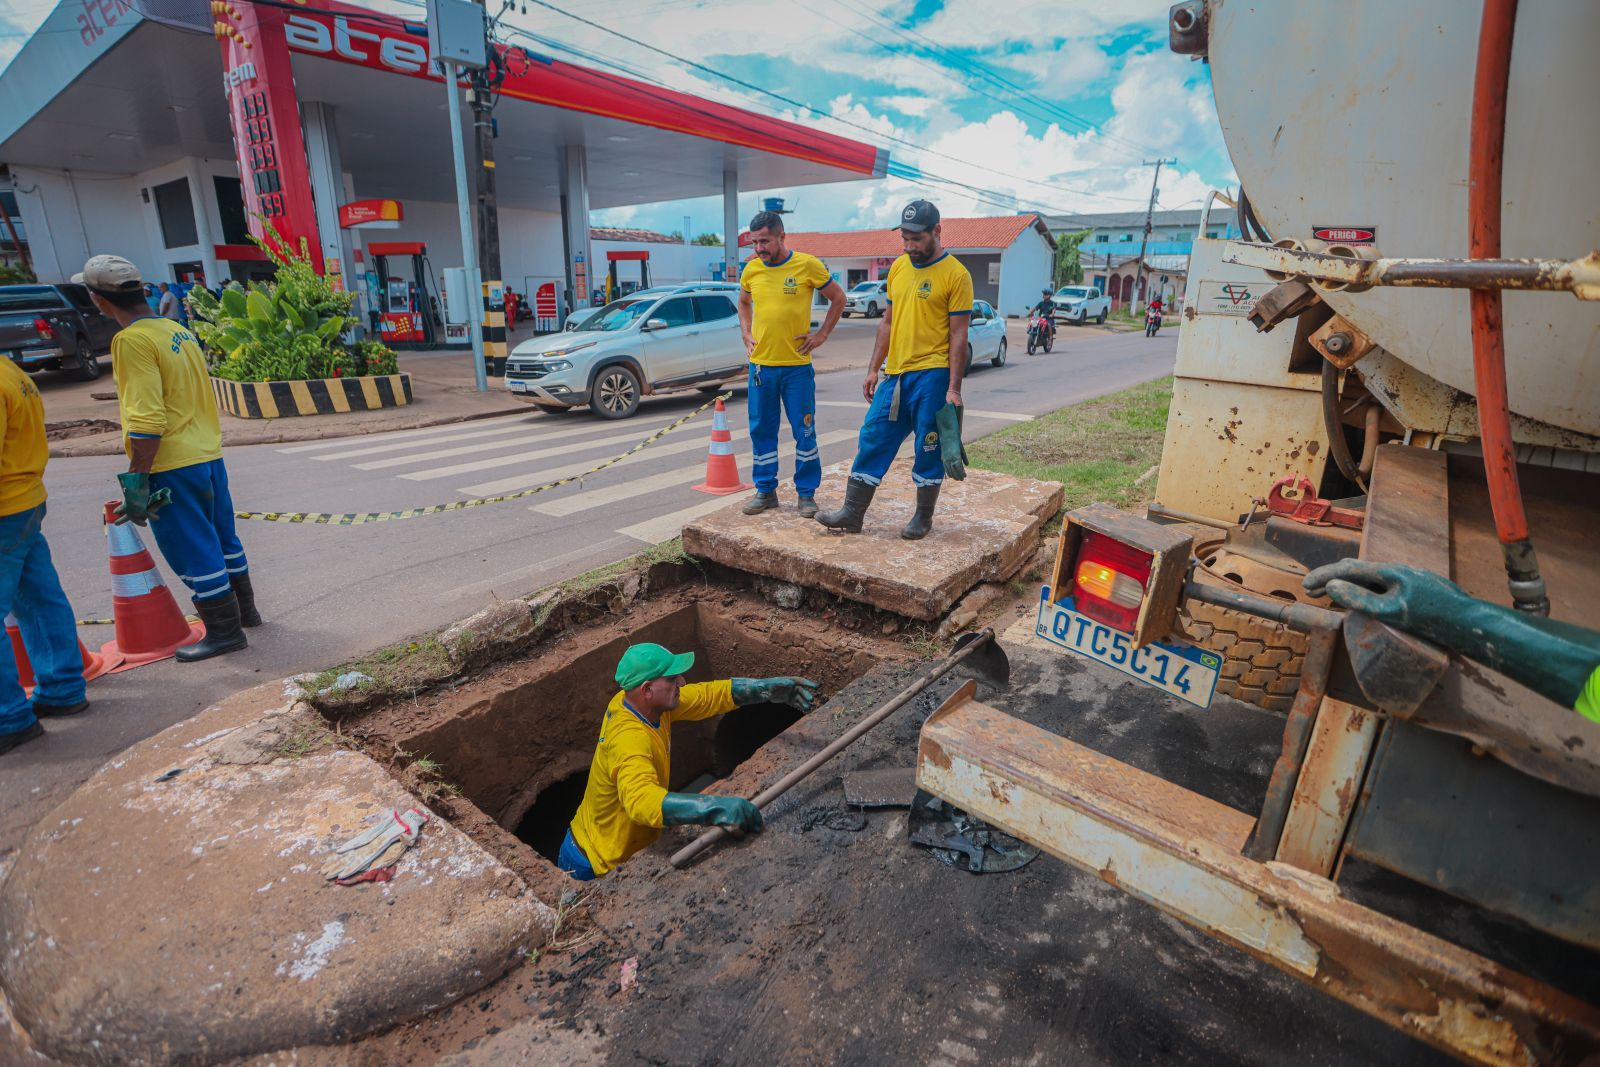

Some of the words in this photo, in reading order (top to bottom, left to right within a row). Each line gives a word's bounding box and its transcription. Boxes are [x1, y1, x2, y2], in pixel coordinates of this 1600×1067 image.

[284, 14, 466, 79] ate
[1328, 230, 1357, 240] PERIGO
[1038, 623, 1048, 635] BR
[1053, 611, 1191, 694] QTC5C14
